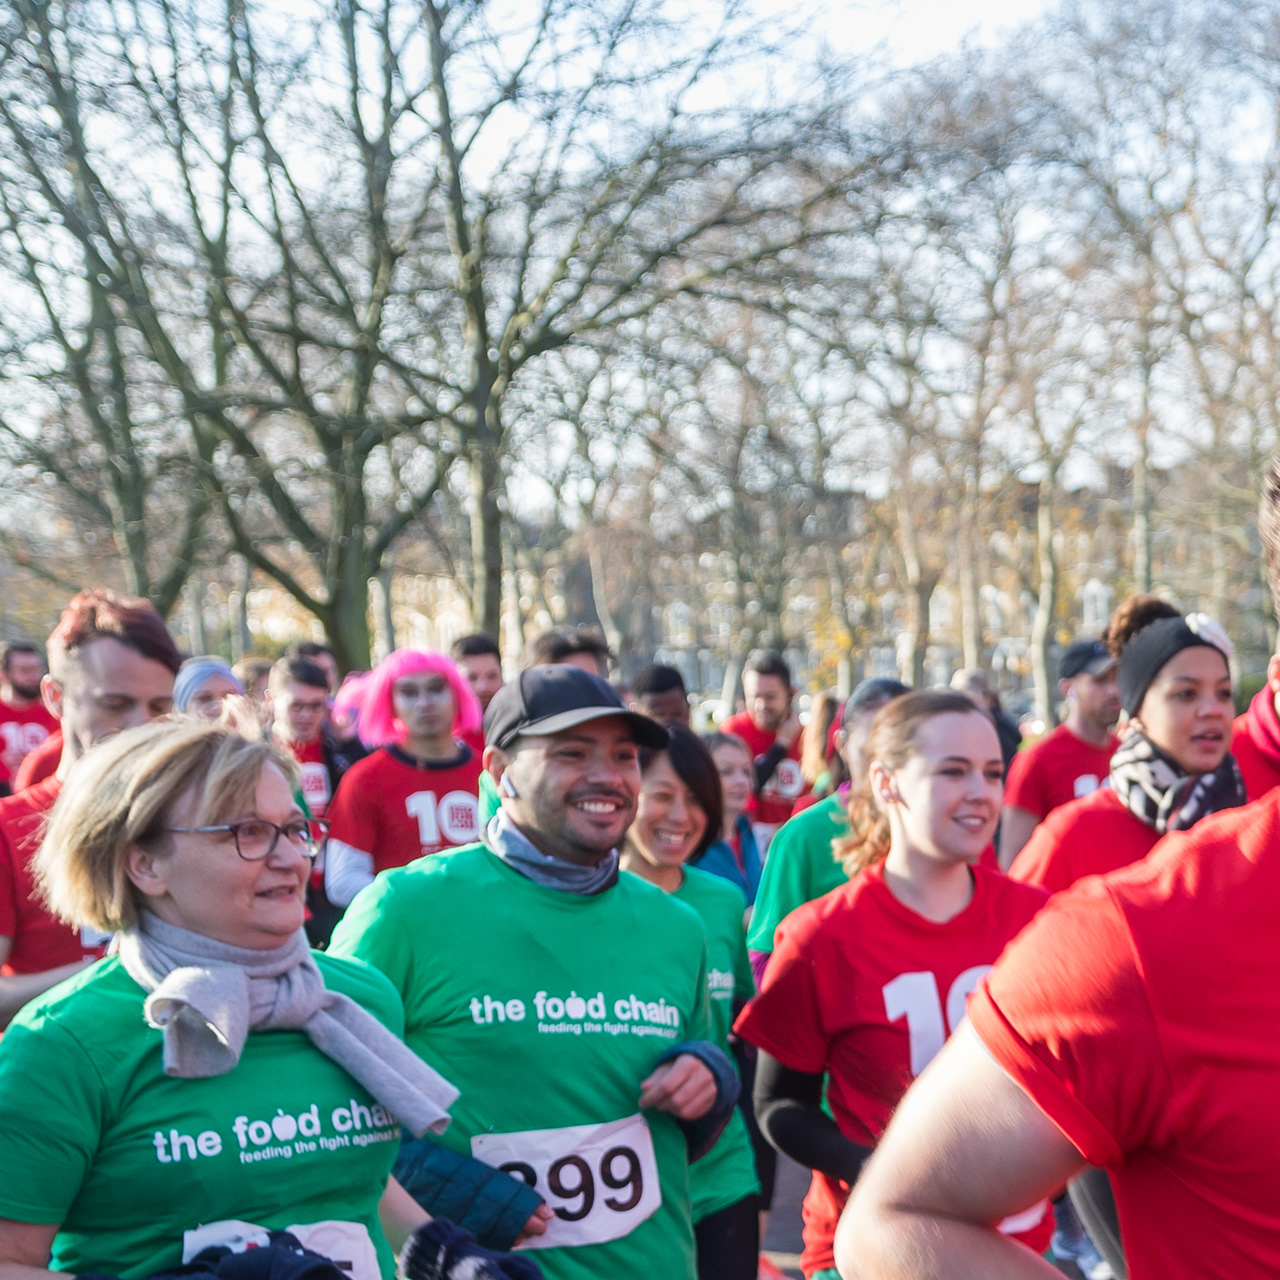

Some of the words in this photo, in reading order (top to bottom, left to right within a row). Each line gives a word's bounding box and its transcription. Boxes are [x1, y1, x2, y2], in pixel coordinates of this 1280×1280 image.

[405, 790, 479, 845] 10
[470, 995, 525, 1024] the
[613, 994, 679, 1026] chain
[537, 1021, 582, 1036] feeding
[583, 1022, 602, 1033] the
[603, 1022, 629, 1035] fight
[153, 1129, 222, 1163] the
[239, 1144, 293, 1164] feeding
[294, 1139, 317, 1155] the
[319, 1133, 351, 1151] fight
